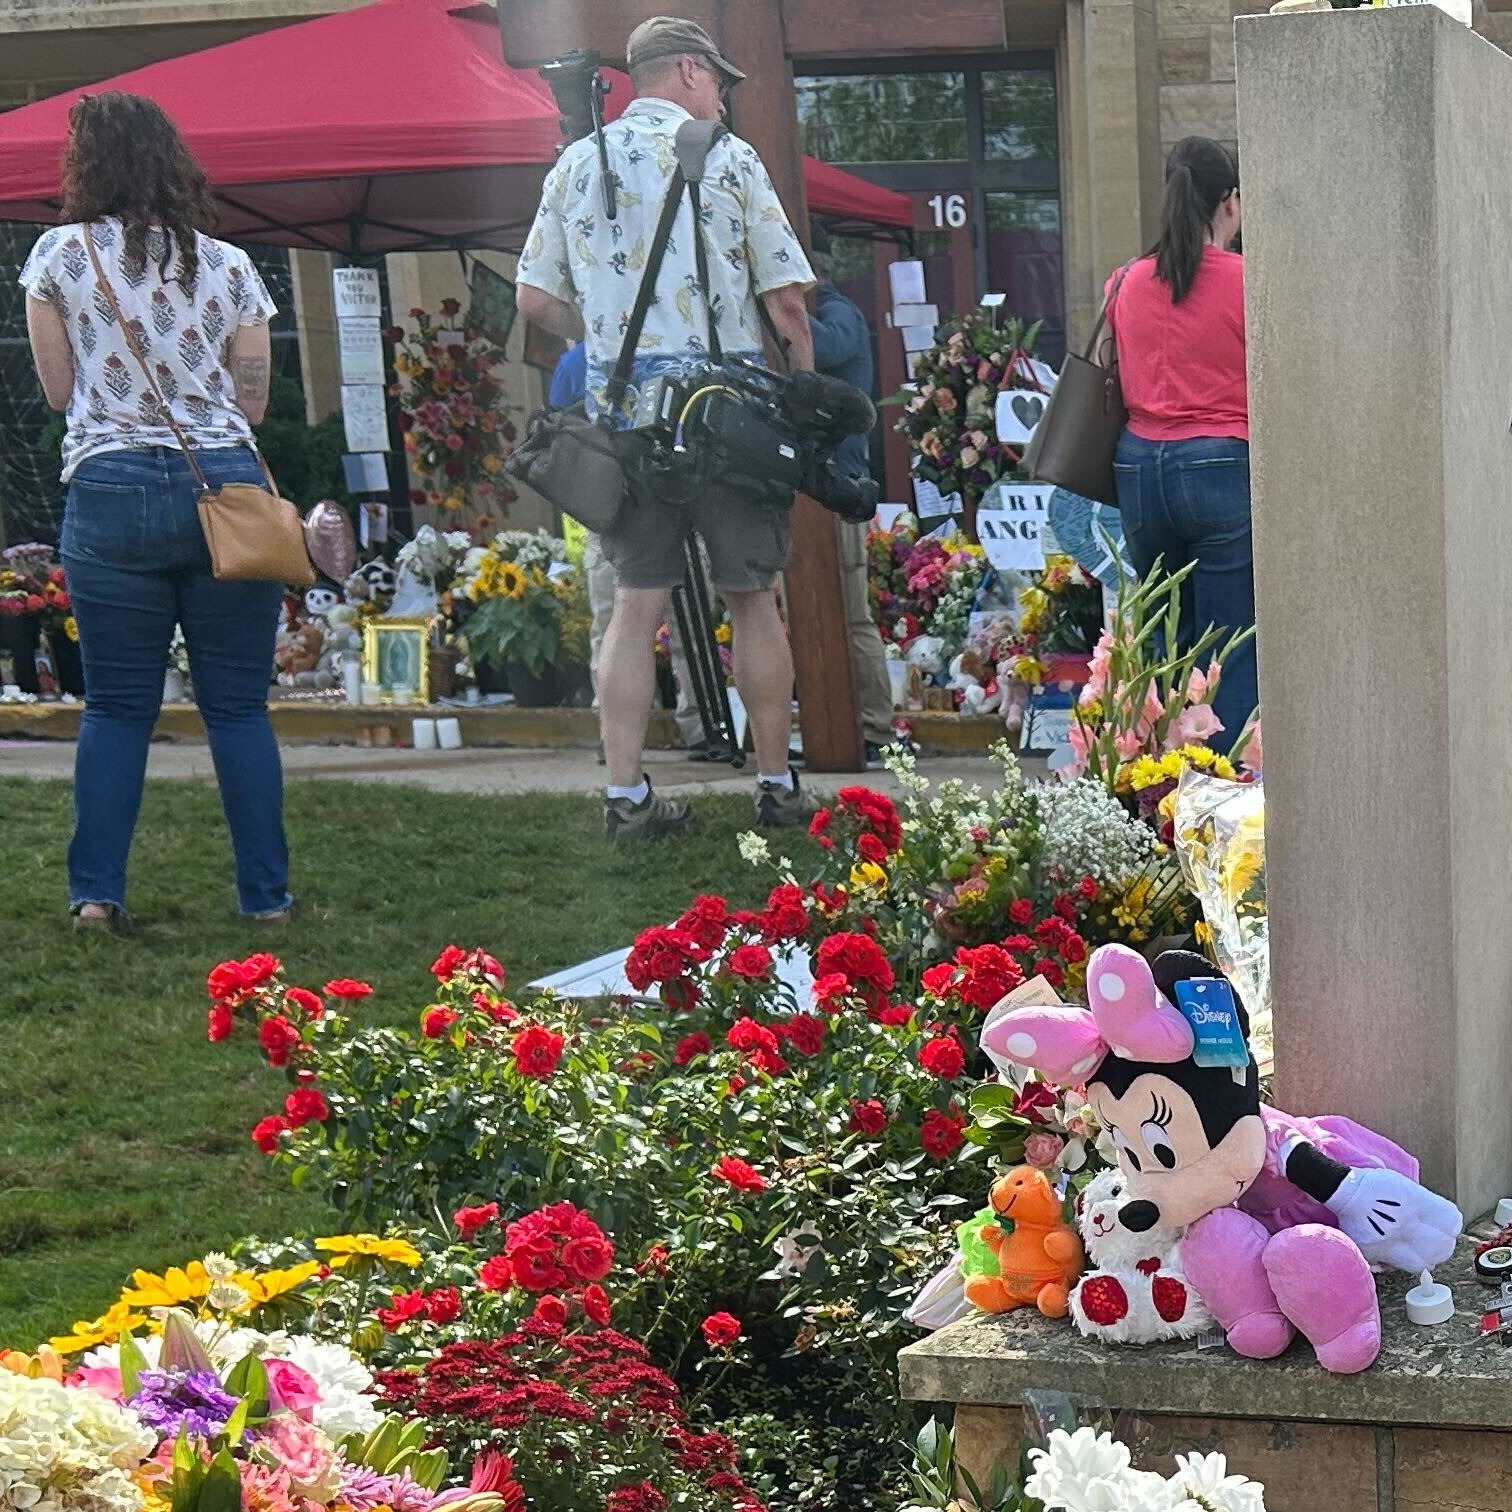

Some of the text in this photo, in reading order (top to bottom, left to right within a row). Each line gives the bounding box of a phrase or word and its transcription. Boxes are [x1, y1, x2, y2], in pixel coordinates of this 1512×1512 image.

[928, 195, 966, 228] 16
[979, 520, 1041, 541] ANG
[1184, 1000, 1232, 1031] Disney
